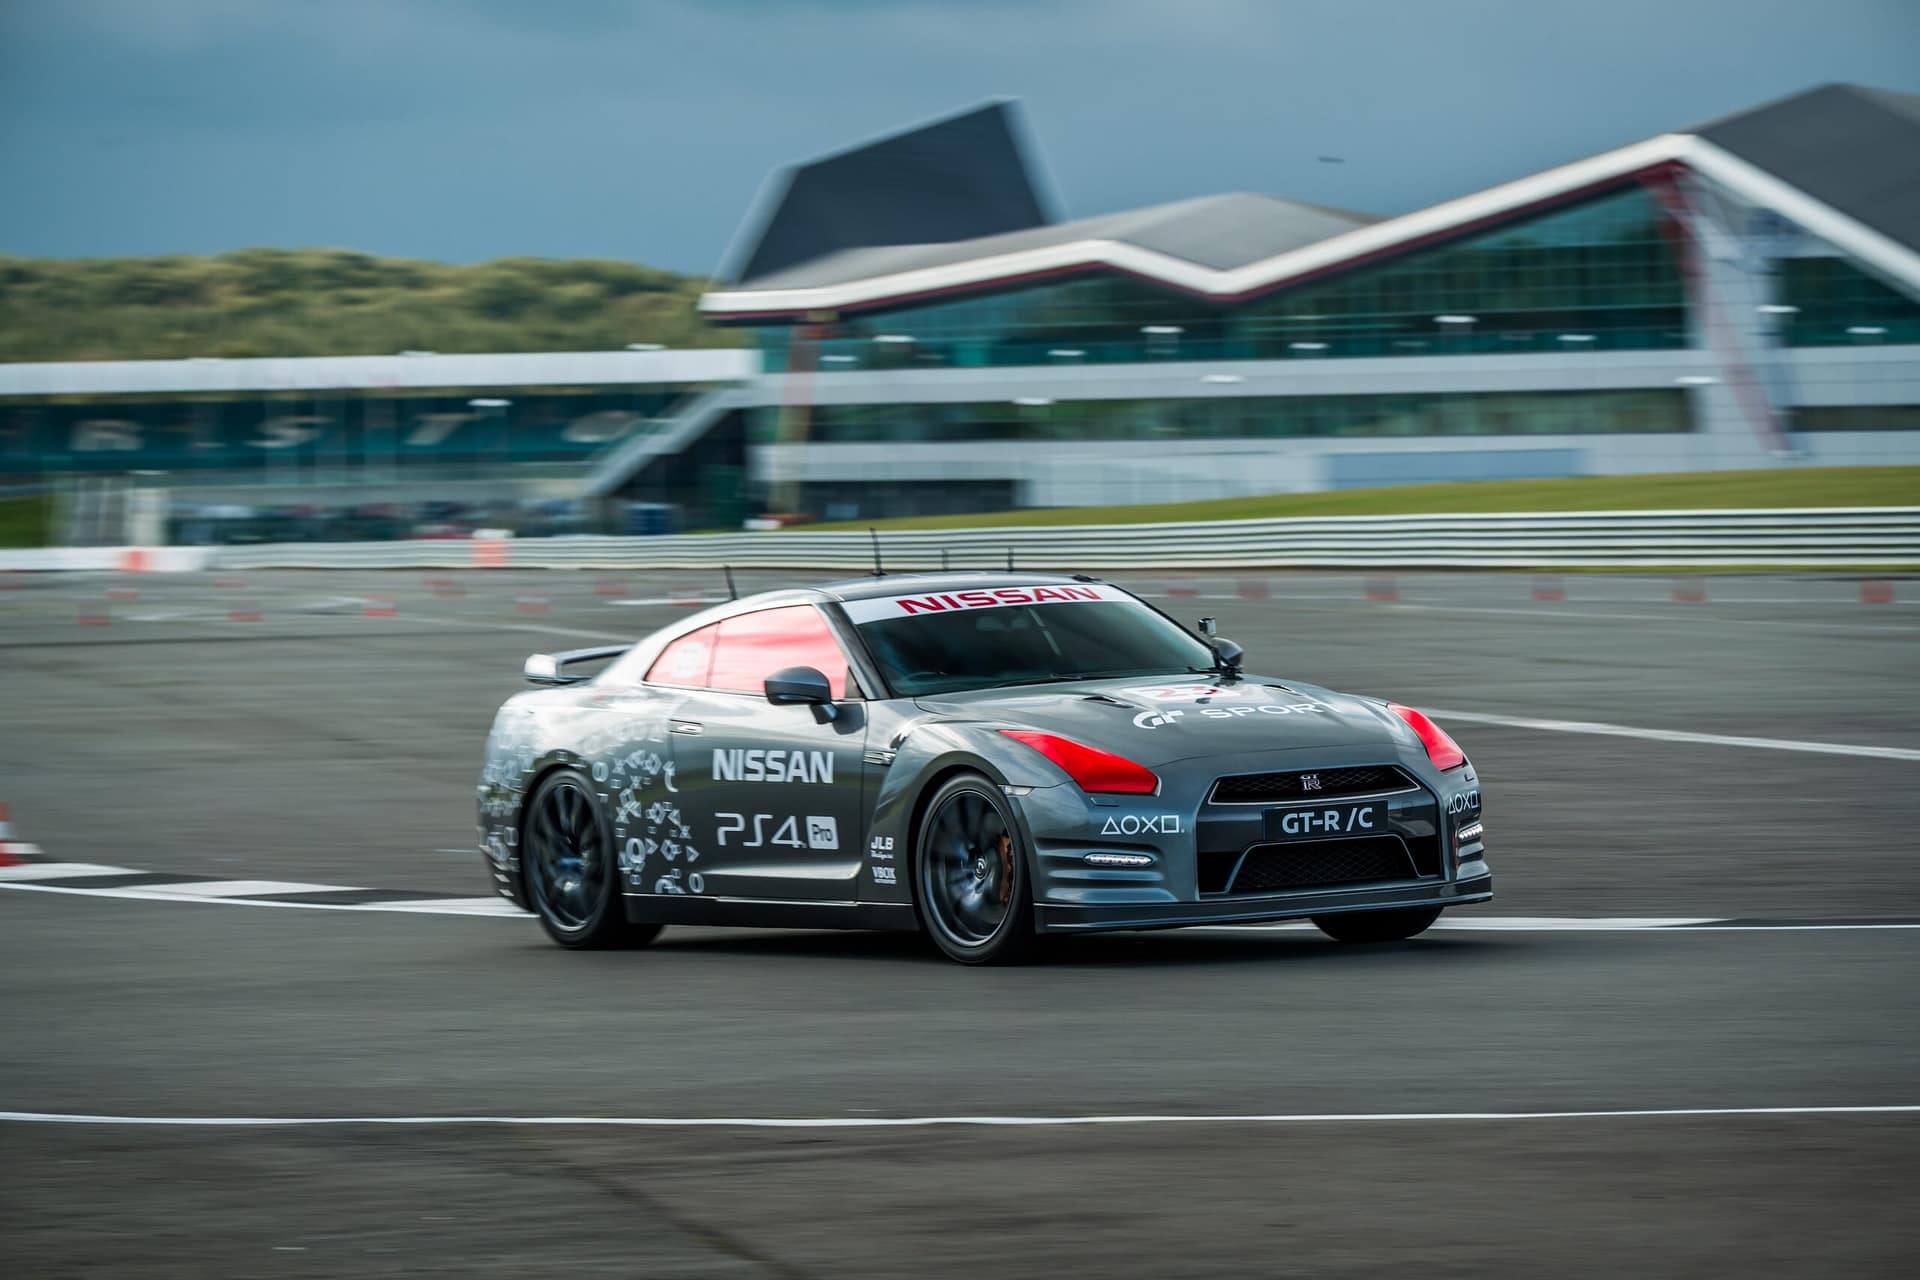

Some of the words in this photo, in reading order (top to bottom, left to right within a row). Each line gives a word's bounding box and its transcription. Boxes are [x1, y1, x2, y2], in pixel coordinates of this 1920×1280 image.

[896, 587, 1102, 614] NISSAN
[1199, 701, 1345, 719] SPORT
[712, 748, 834, 784] NISSAN
[714, 812, 806, 848] PS4
[811, 823, 833, 843] Pro
[1282, 810, 1340, 834] GT-R
[1345, 807, 1373, 832] /C
[871, 836, 894, 850] JLB
